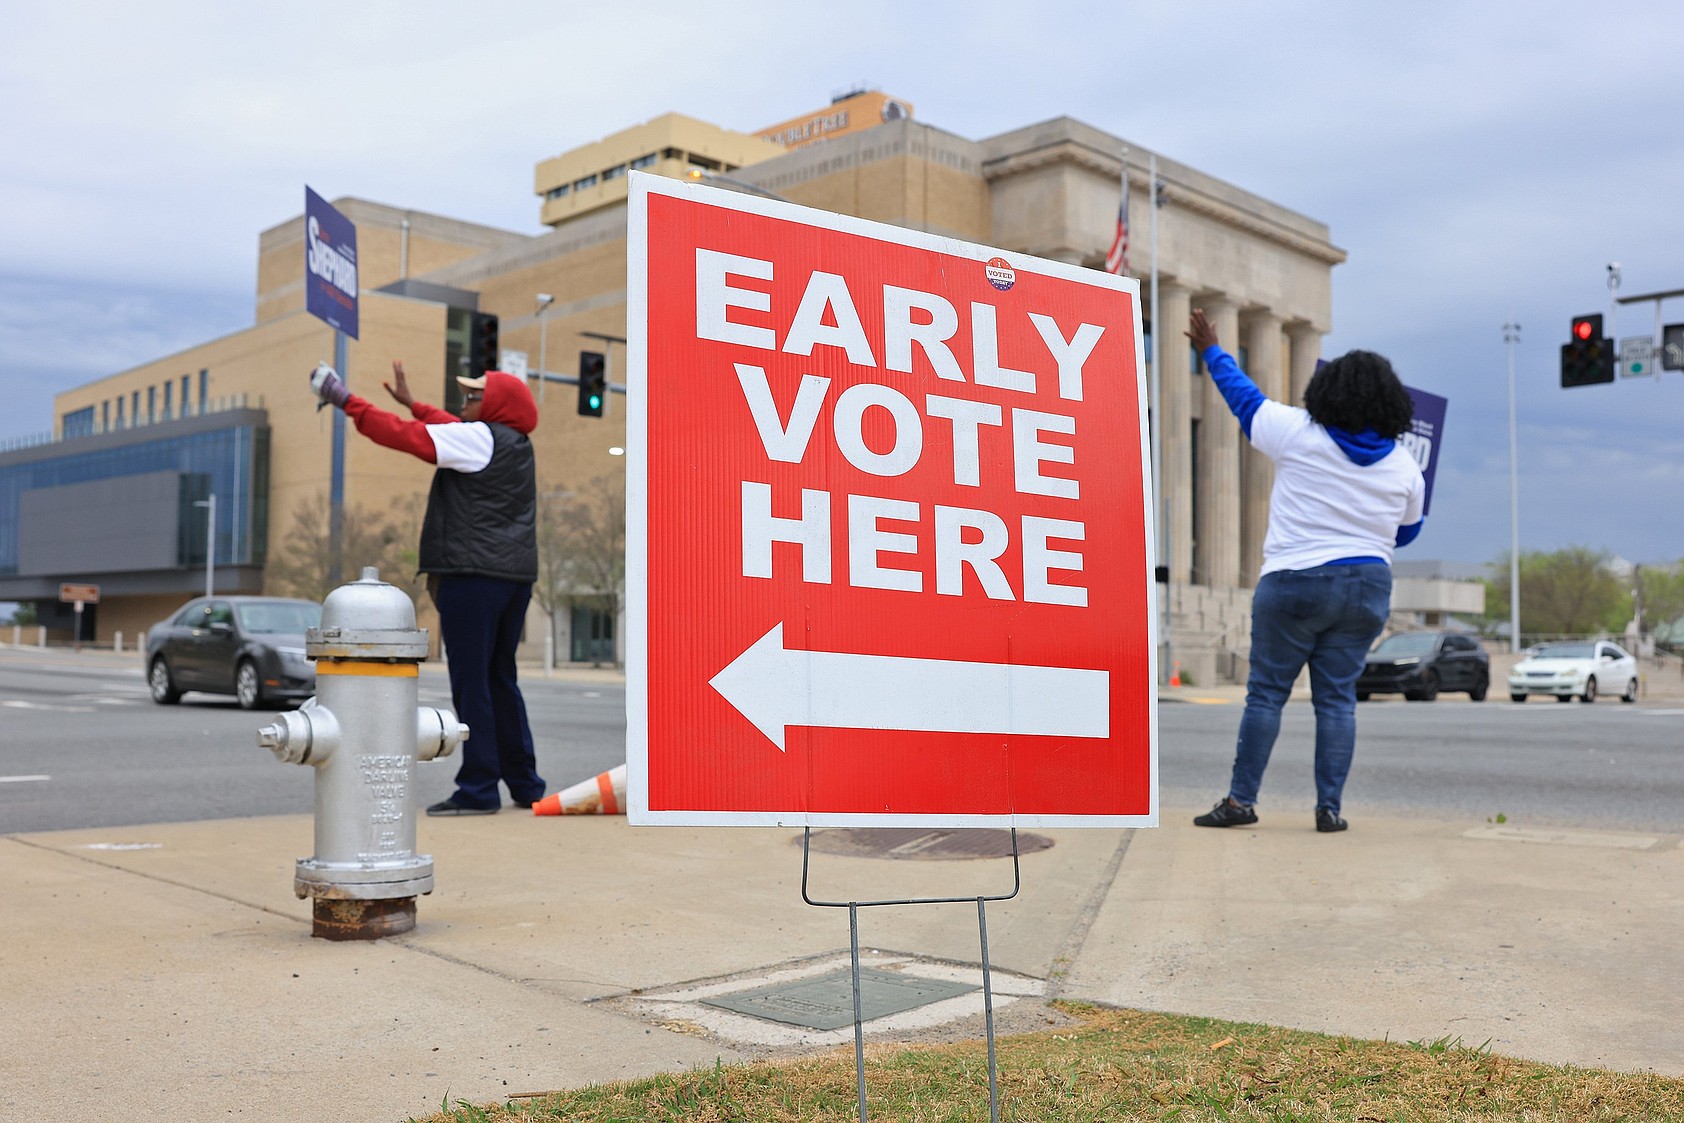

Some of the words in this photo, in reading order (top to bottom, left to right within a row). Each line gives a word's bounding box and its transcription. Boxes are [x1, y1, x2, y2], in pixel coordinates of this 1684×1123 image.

[695, 247, 1106, 402] EARLY
[988, 270, 1012, 279] VOTED
[732, 362, 1080, 501] VOTE
[741, 480, 1089, 608] HERE
